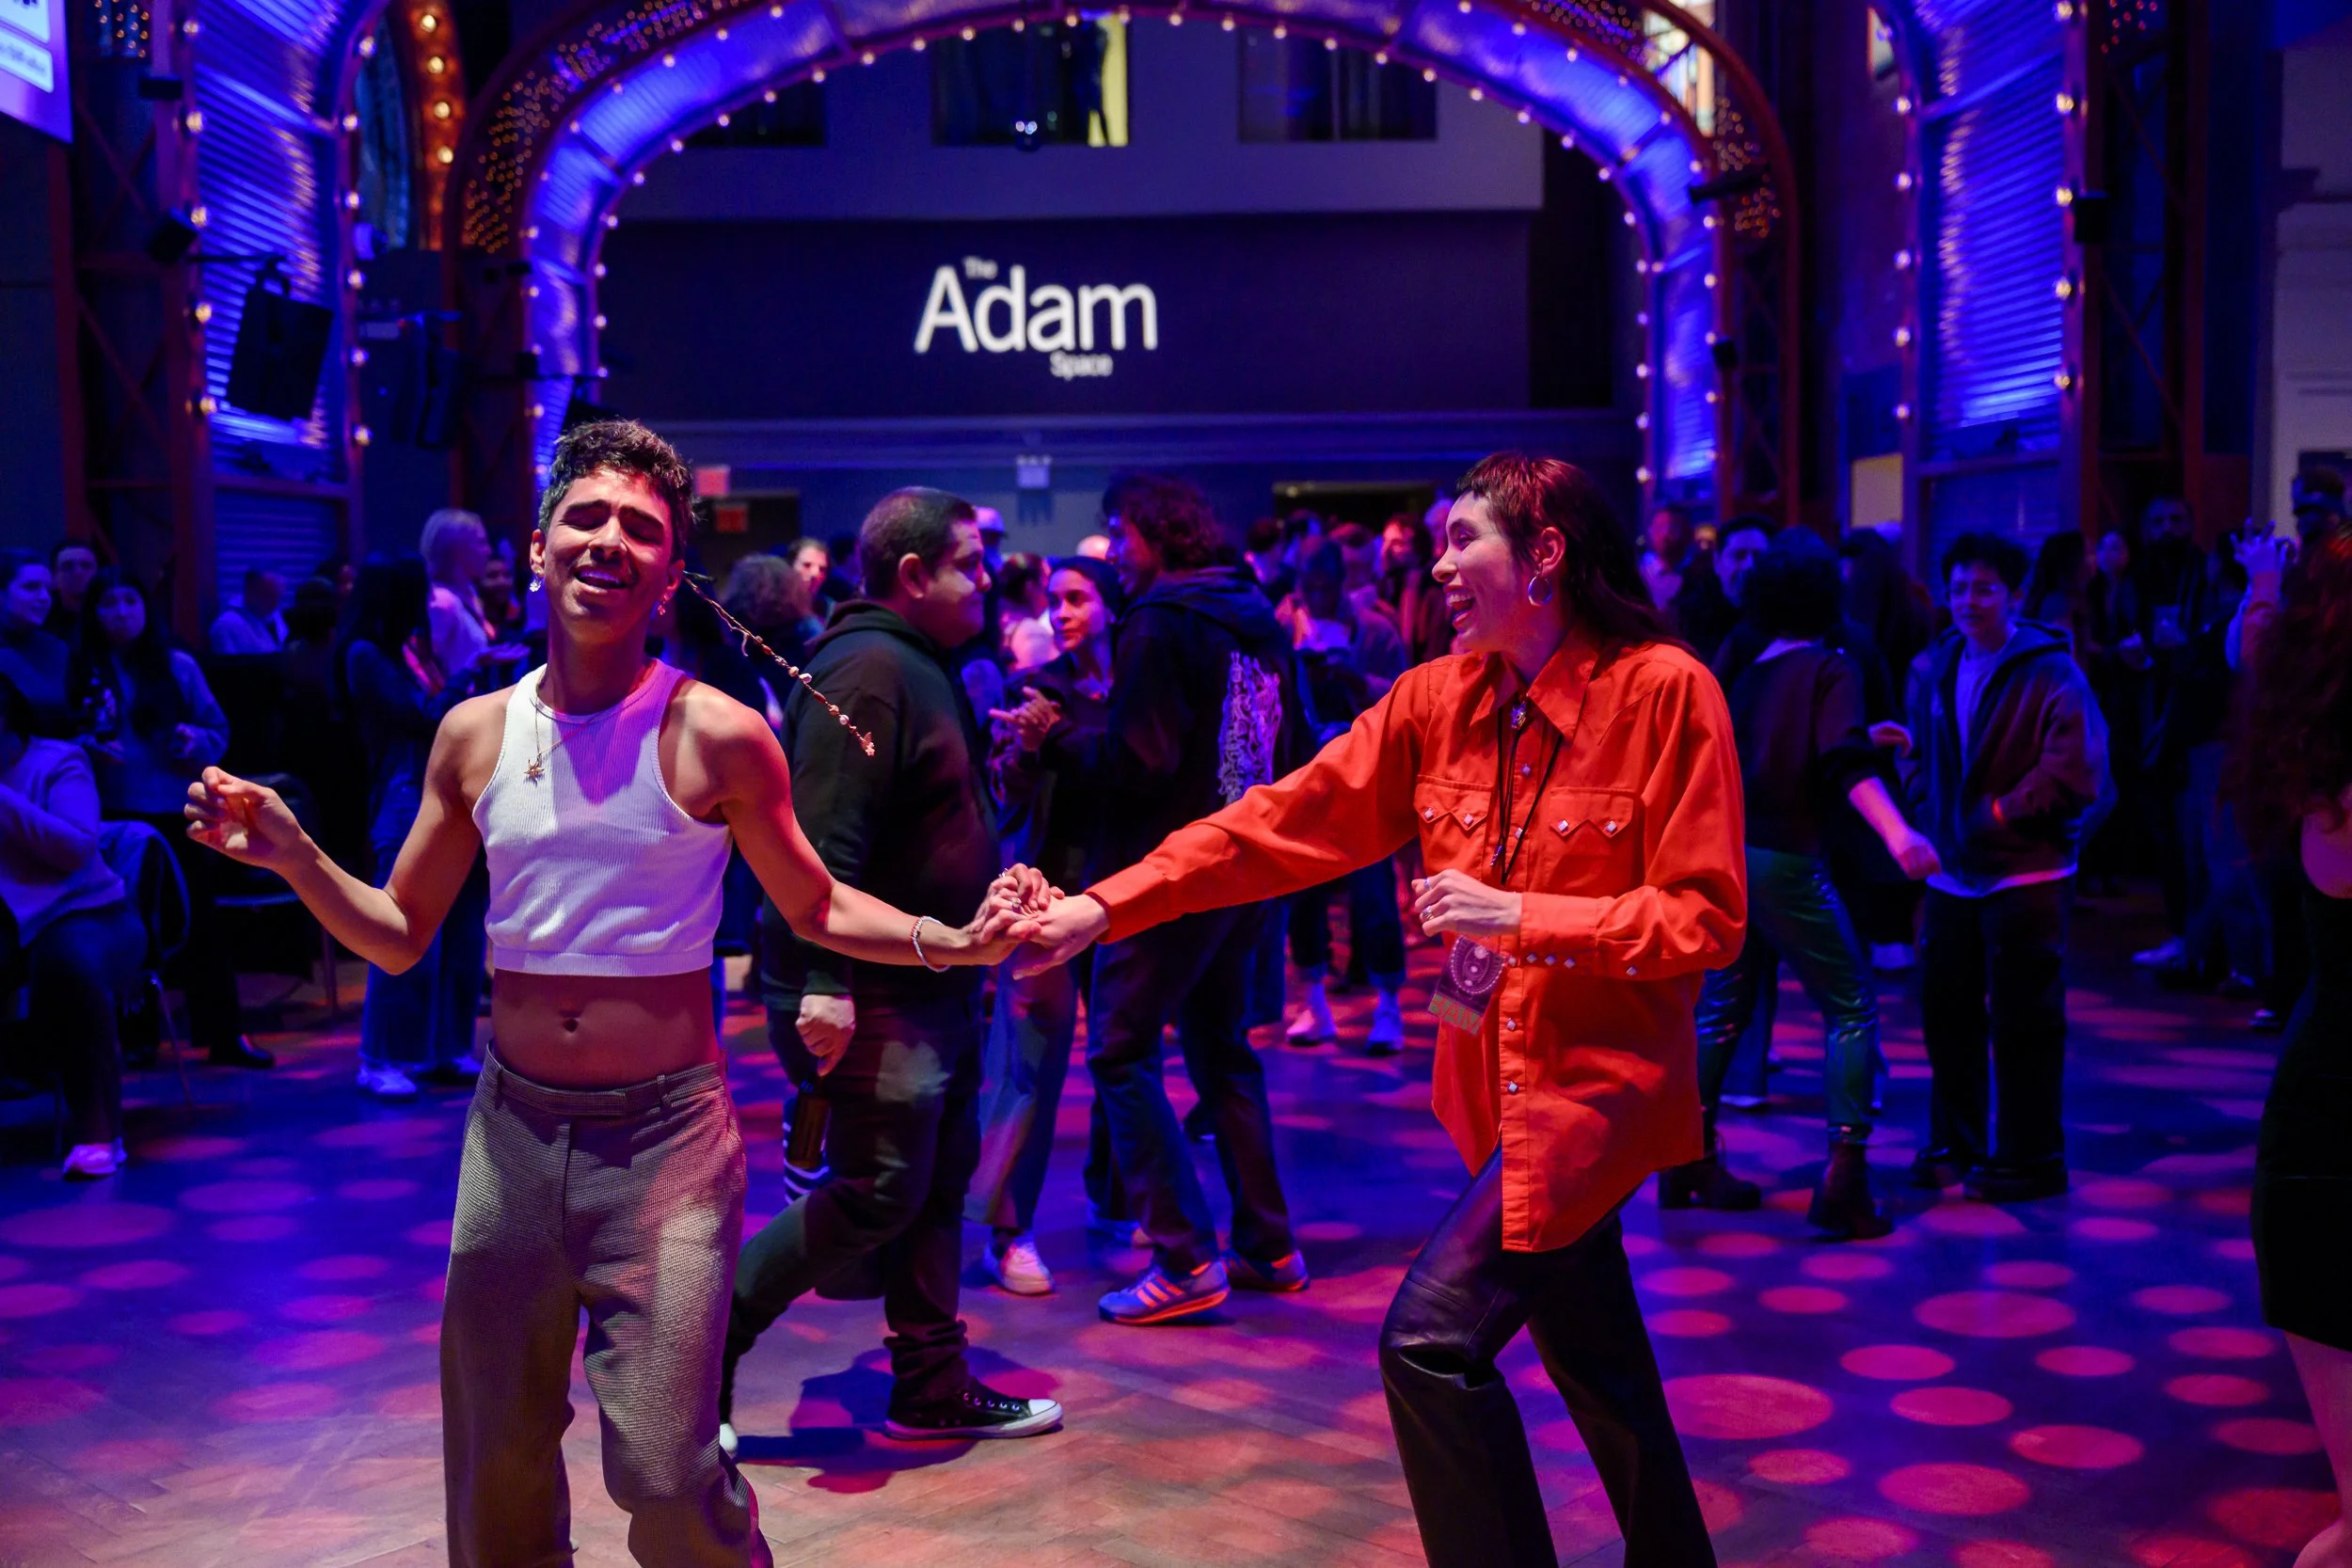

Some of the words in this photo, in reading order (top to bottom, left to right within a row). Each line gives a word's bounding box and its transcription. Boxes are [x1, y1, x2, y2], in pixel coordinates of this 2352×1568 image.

[962, 255, 998, 279] The
[914, 264, 1157, 353] Adam
[1050, 351, 1114, 380] Space
